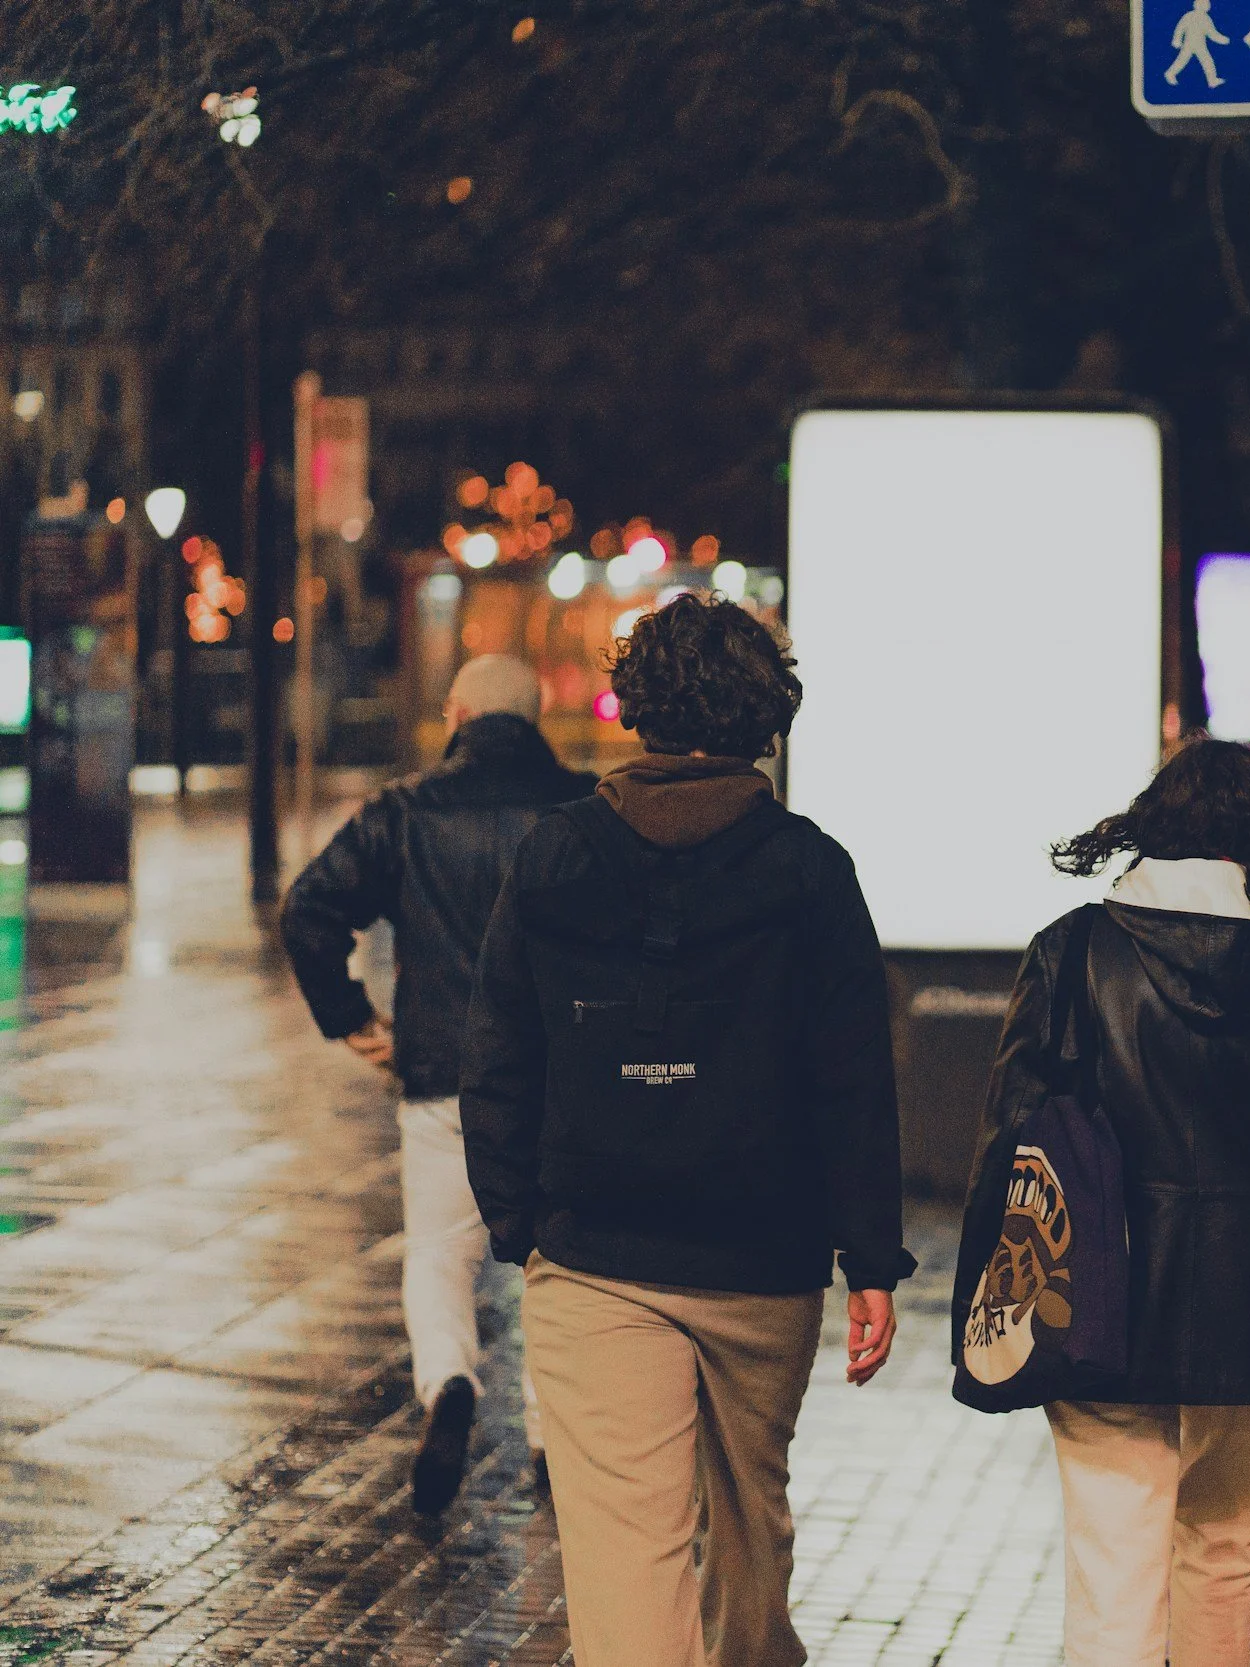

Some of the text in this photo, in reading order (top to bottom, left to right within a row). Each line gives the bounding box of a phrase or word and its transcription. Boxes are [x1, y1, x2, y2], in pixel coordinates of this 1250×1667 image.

[621, 1063, 696, 1077] NORTHERN MONK
[646, 1076, 663, 1085] BREW
